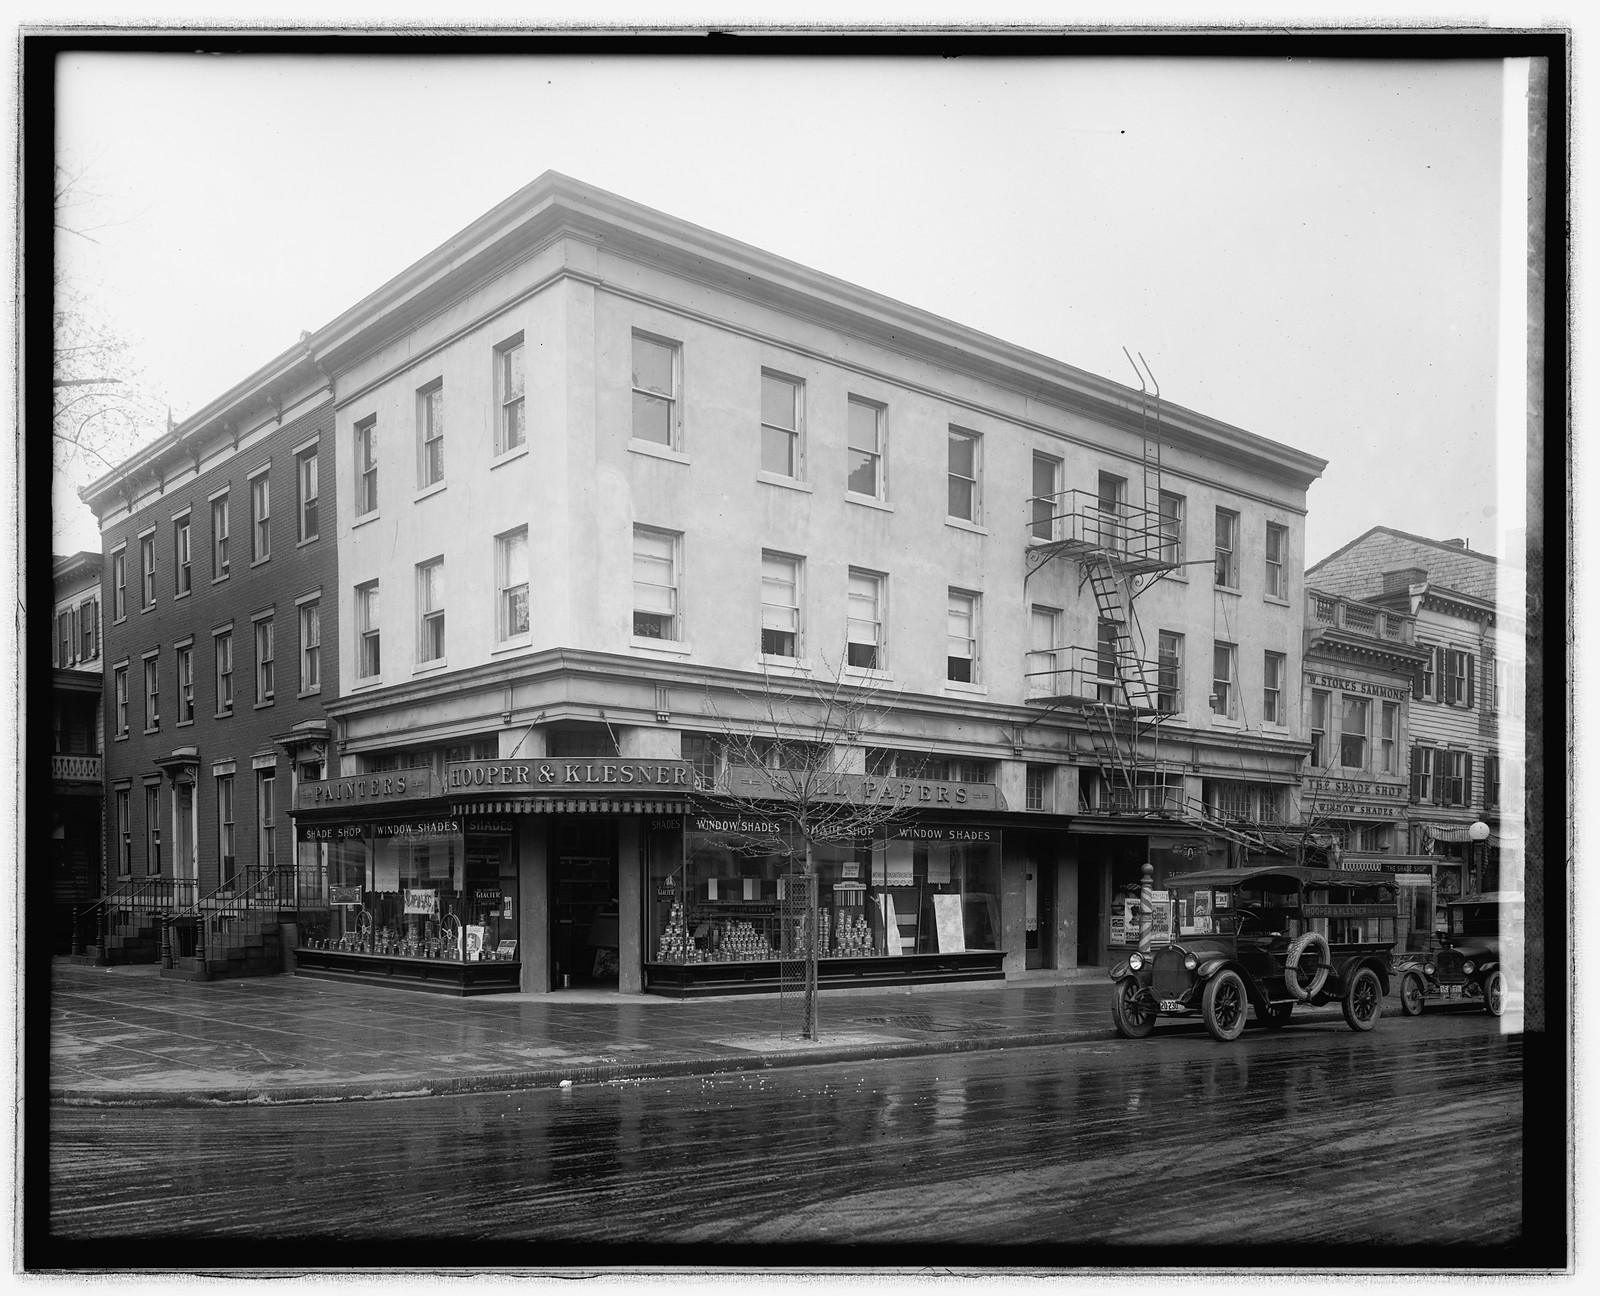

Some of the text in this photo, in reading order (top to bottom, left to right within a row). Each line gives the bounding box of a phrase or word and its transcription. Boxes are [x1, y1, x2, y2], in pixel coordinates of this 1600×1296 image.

[1308, 673, 1405, 700] W. STOKES SAMMONS
[451, 764, 688, 788] HOOPER & KLESNER
[314, 776, 407, 802] PAINTERS
[864, 781, 968, 803] PAPERS
[1308, 779, 1403, 798] THE SHADE SHOP
[1318, 803, 1394, 816] WINDOW SHADES
[377, 821, 459, 835] WINDOW SHADES
[469, 820, 514, 832] SHADES
[651, 819, 681, 831] SHADES
[697, 819, 781, 833] WINDOW SHADES
[846, 826, 875, 837] SHOP
[306, 827, 362, 839] SHADE SHOP
[899, 827, 991, 841] WINDOW SHADES
[476, 891, 501, 899] GLACIER
[1305, 906, 1332, 916] HOOPER
[1339, 906, 1367, 916] KLESNER
